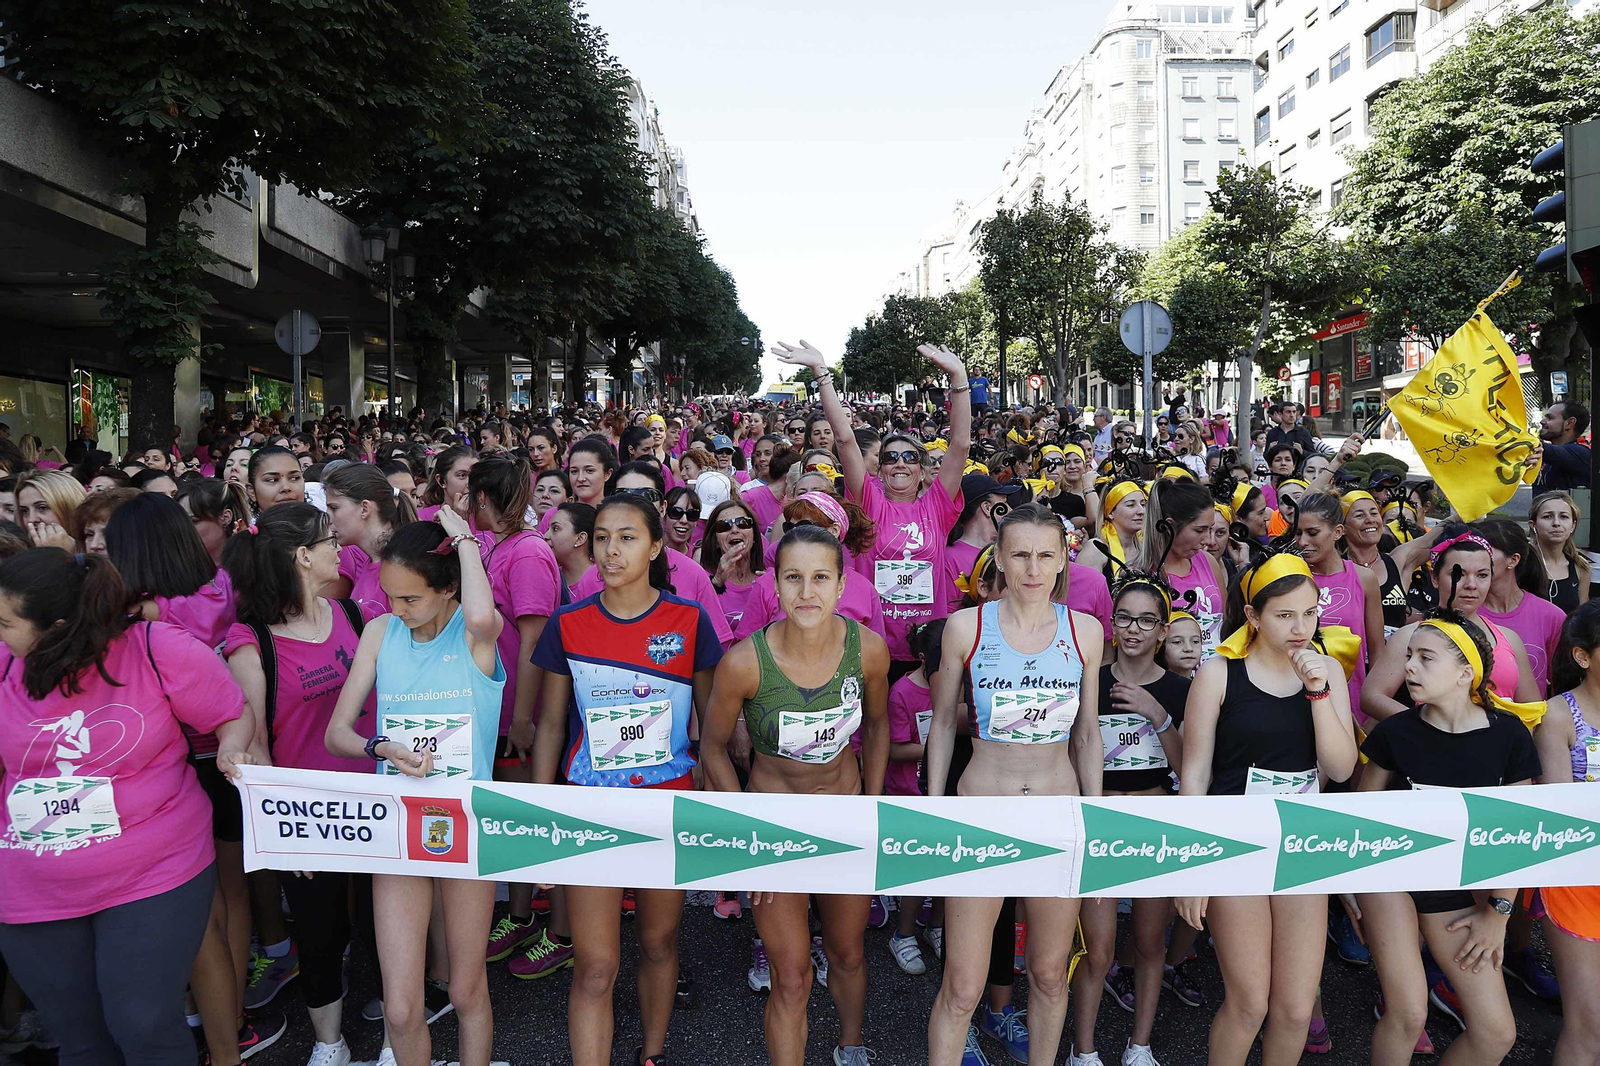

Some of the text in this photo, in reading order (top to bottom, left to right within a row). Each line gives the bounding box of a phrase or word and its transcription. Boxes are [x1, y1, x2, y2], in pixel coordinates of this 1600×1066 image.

[1336, 319, 1361, 333] Santander
[897, 574, 913, 585] 396
[296, 665, 306, 674] IX
[300, 664, 334, 681] CARRERA
[302, 671, 340, 690] FEMENINA
[978, 675, 1081, 690] Celta Atletism
[380, 687, 473, 702] w.soniaalonso.es
[1023, 707, 1048, 722] 274
[620, 724, 645, 741] 890
[814, 727, 836, 743] 143
[1118, 732, 1140, 746] 906
[413, 737, 437, 753] 223
[43, 798, 81, 817] 1294
[261, 799, 388, 821] CONCELLO
[278, 821, 373, 843] DE VIGO
[481, 818, 619, 846] El Corte Inglés
[1469, 820, 1597, 852] El Corte Inglés
[678, 831, 819, 857] El Corte Inglés
[882, 835, 1022, 863] El Corte Inglés
[1088, 835, 1224, 863] El Corte Inglés
[1284, 829, 1415, 858] El Corte Inglés
